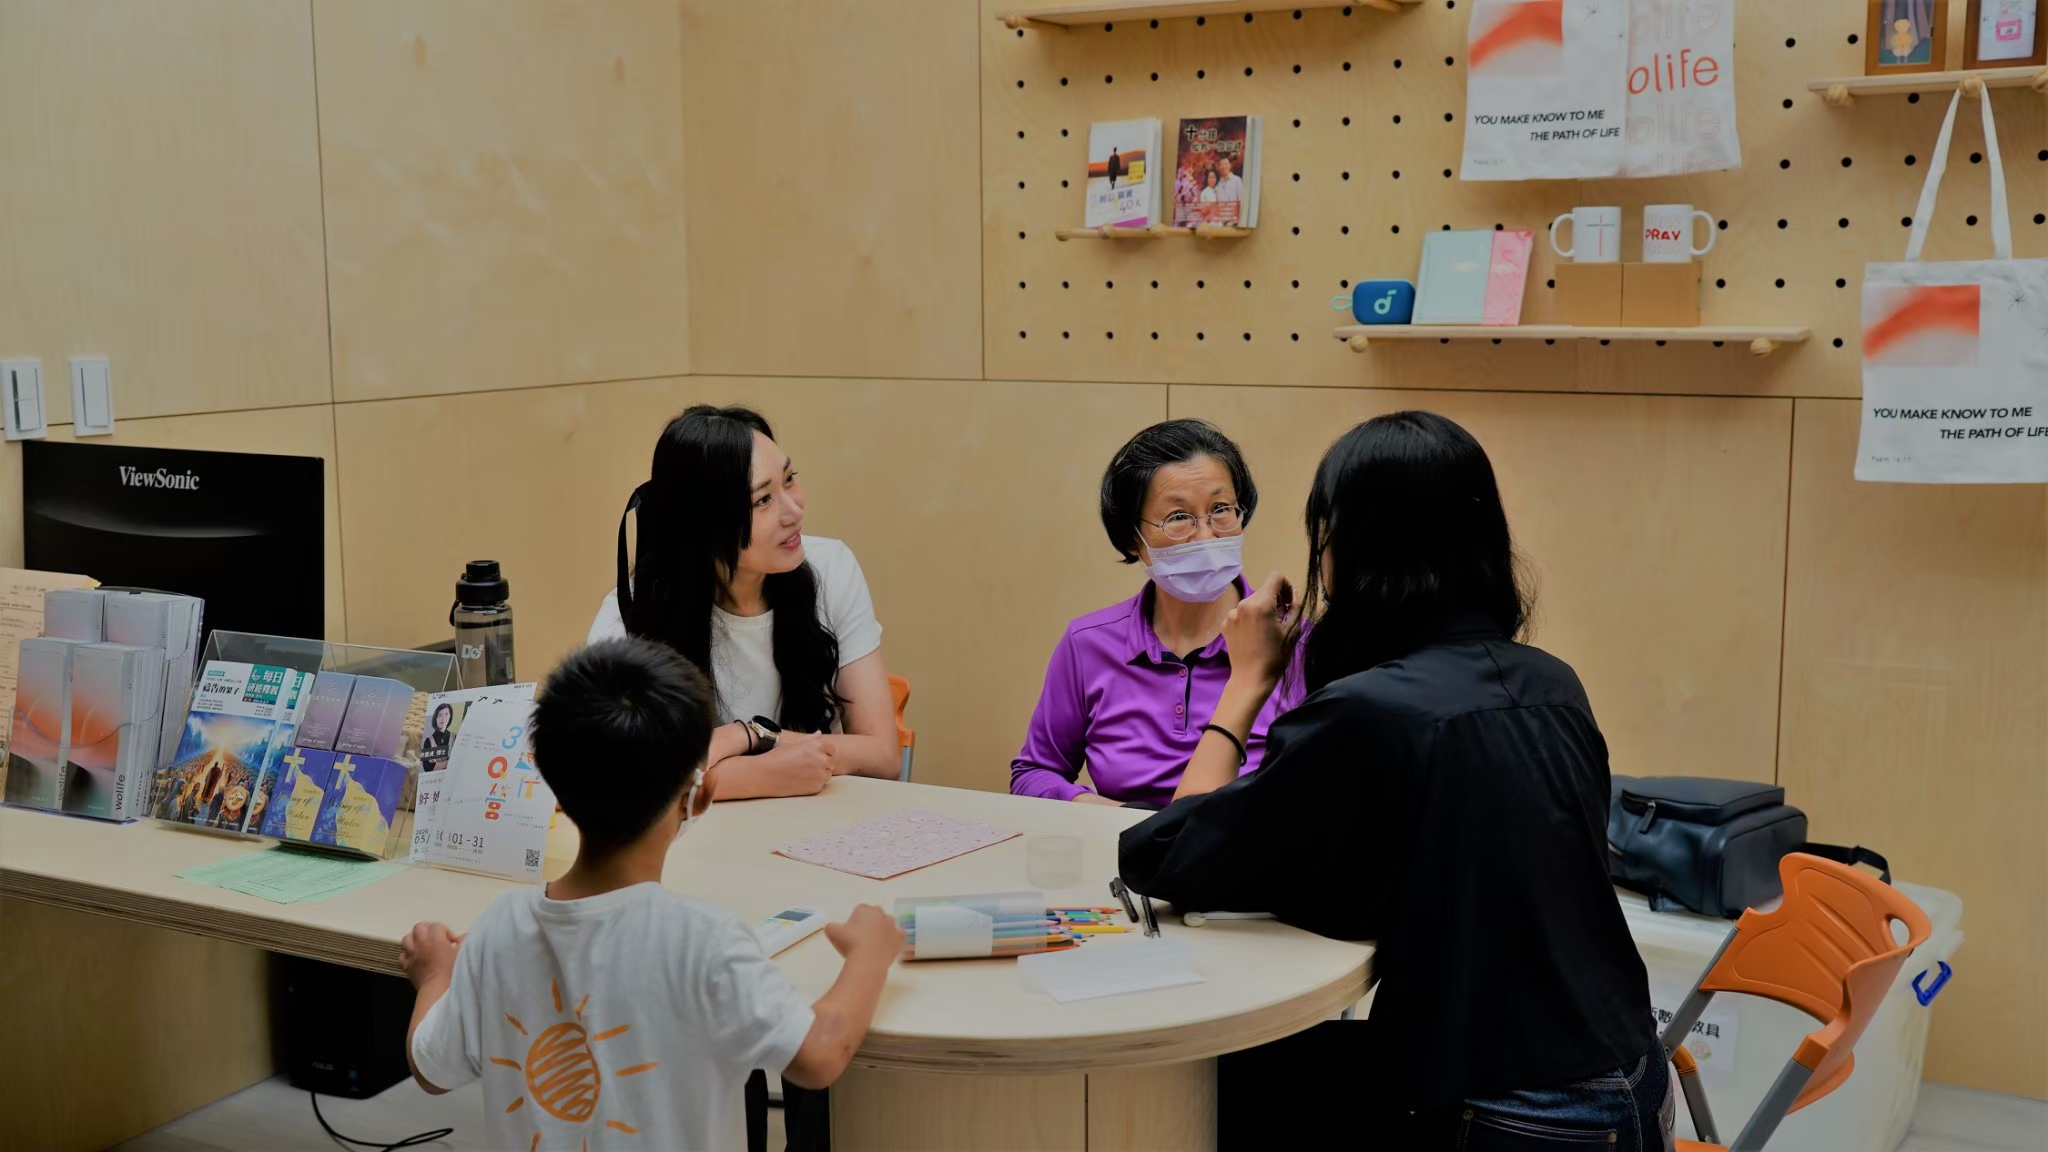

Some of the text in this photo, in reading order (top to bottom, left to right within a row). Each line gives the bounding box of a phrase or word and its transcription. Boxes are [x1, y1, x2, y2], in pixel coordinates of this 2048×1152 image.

[1474, 109, 1604, 125] YOU MAKE KNOW TO ME
[1530, 127, 1620, 142] THE PATH OF LIFE
[1645, 228, 1682, 242] PRAY
[1873, 406, 2033, 420] YOU MAKE KNOW TO ME
[1940, 429, 1965, 440] THE
[1968, 428, 2002, 439] PATH
[2004, 427, 2025, 438] OF
[118, 465, 200, 491] ViewSonic
[262, 670, 284, 684] 每日
[57, 765, 67, 801] wolife
[115, 774, 126, 811] wolife
